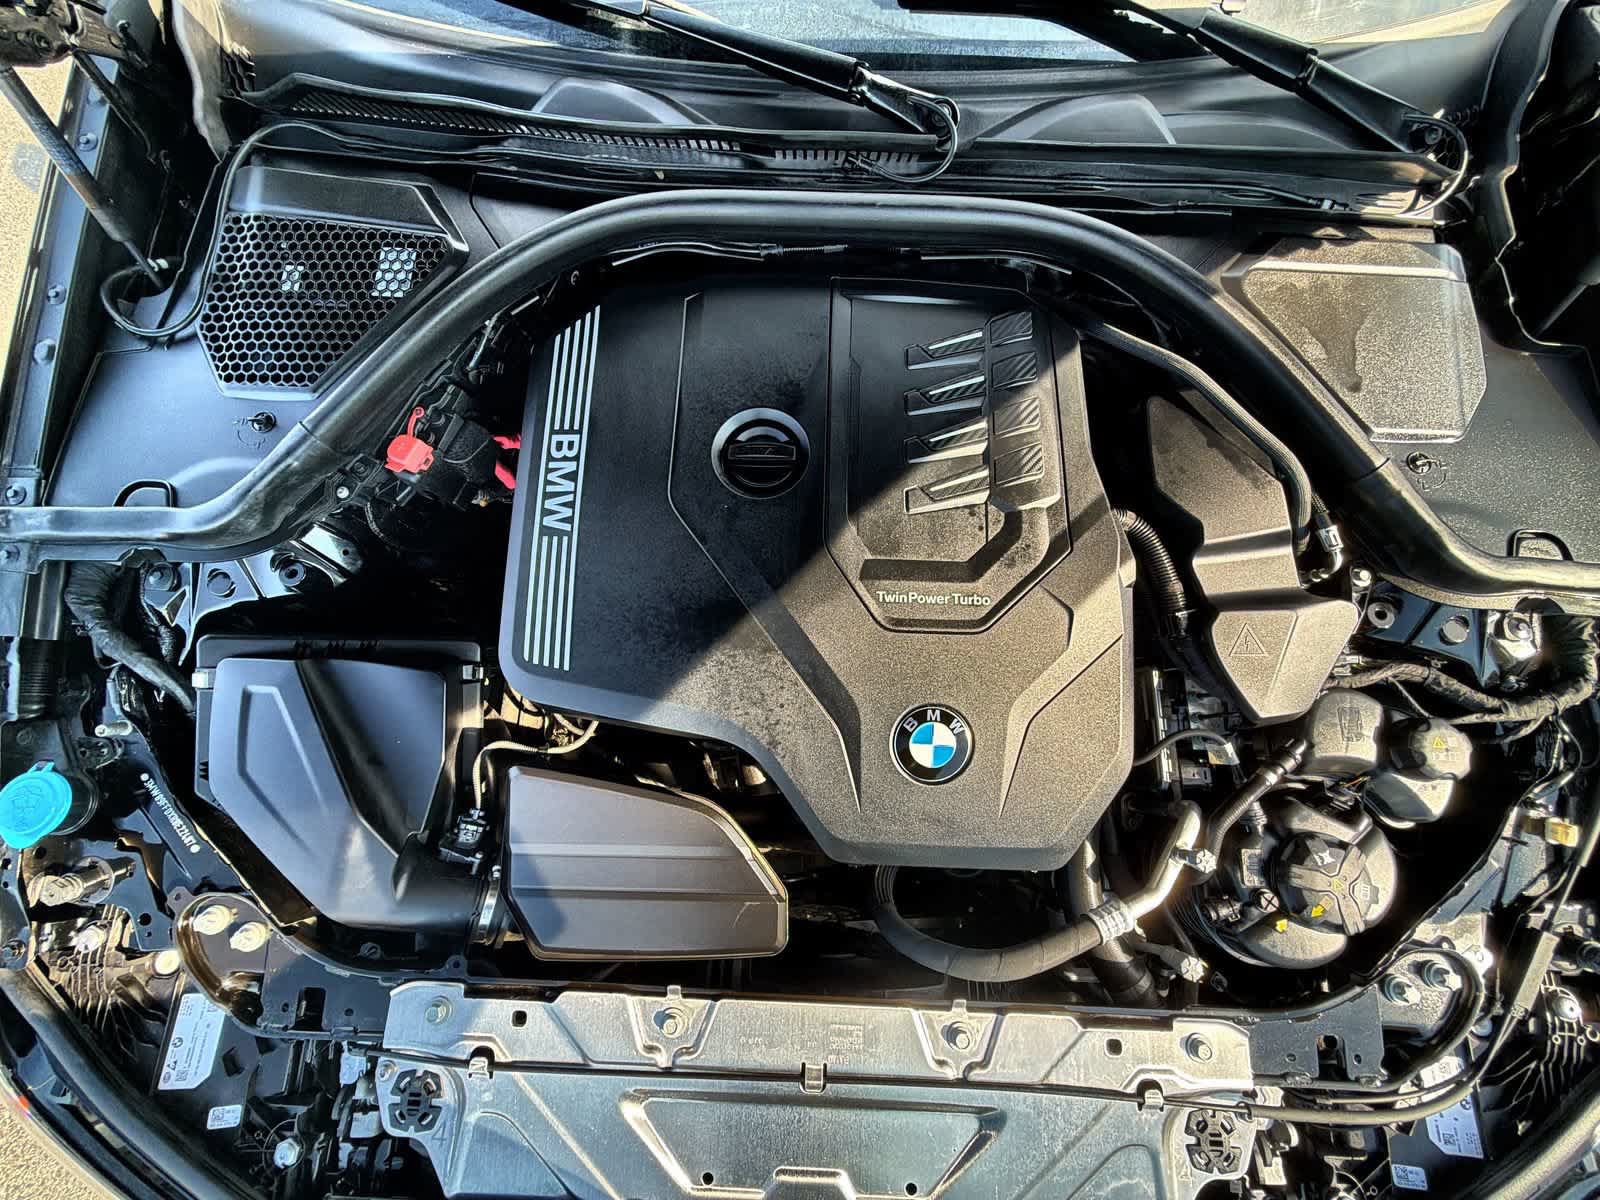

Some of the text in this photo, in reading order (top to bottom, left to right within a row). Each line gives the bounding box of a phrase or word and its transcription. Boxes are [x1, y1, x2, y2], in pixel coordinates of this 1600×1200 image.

[542, 433, 581, 532] BMW
[951, 593, 991, 606] Turbo
[903, 709, 965, 734] BMW
